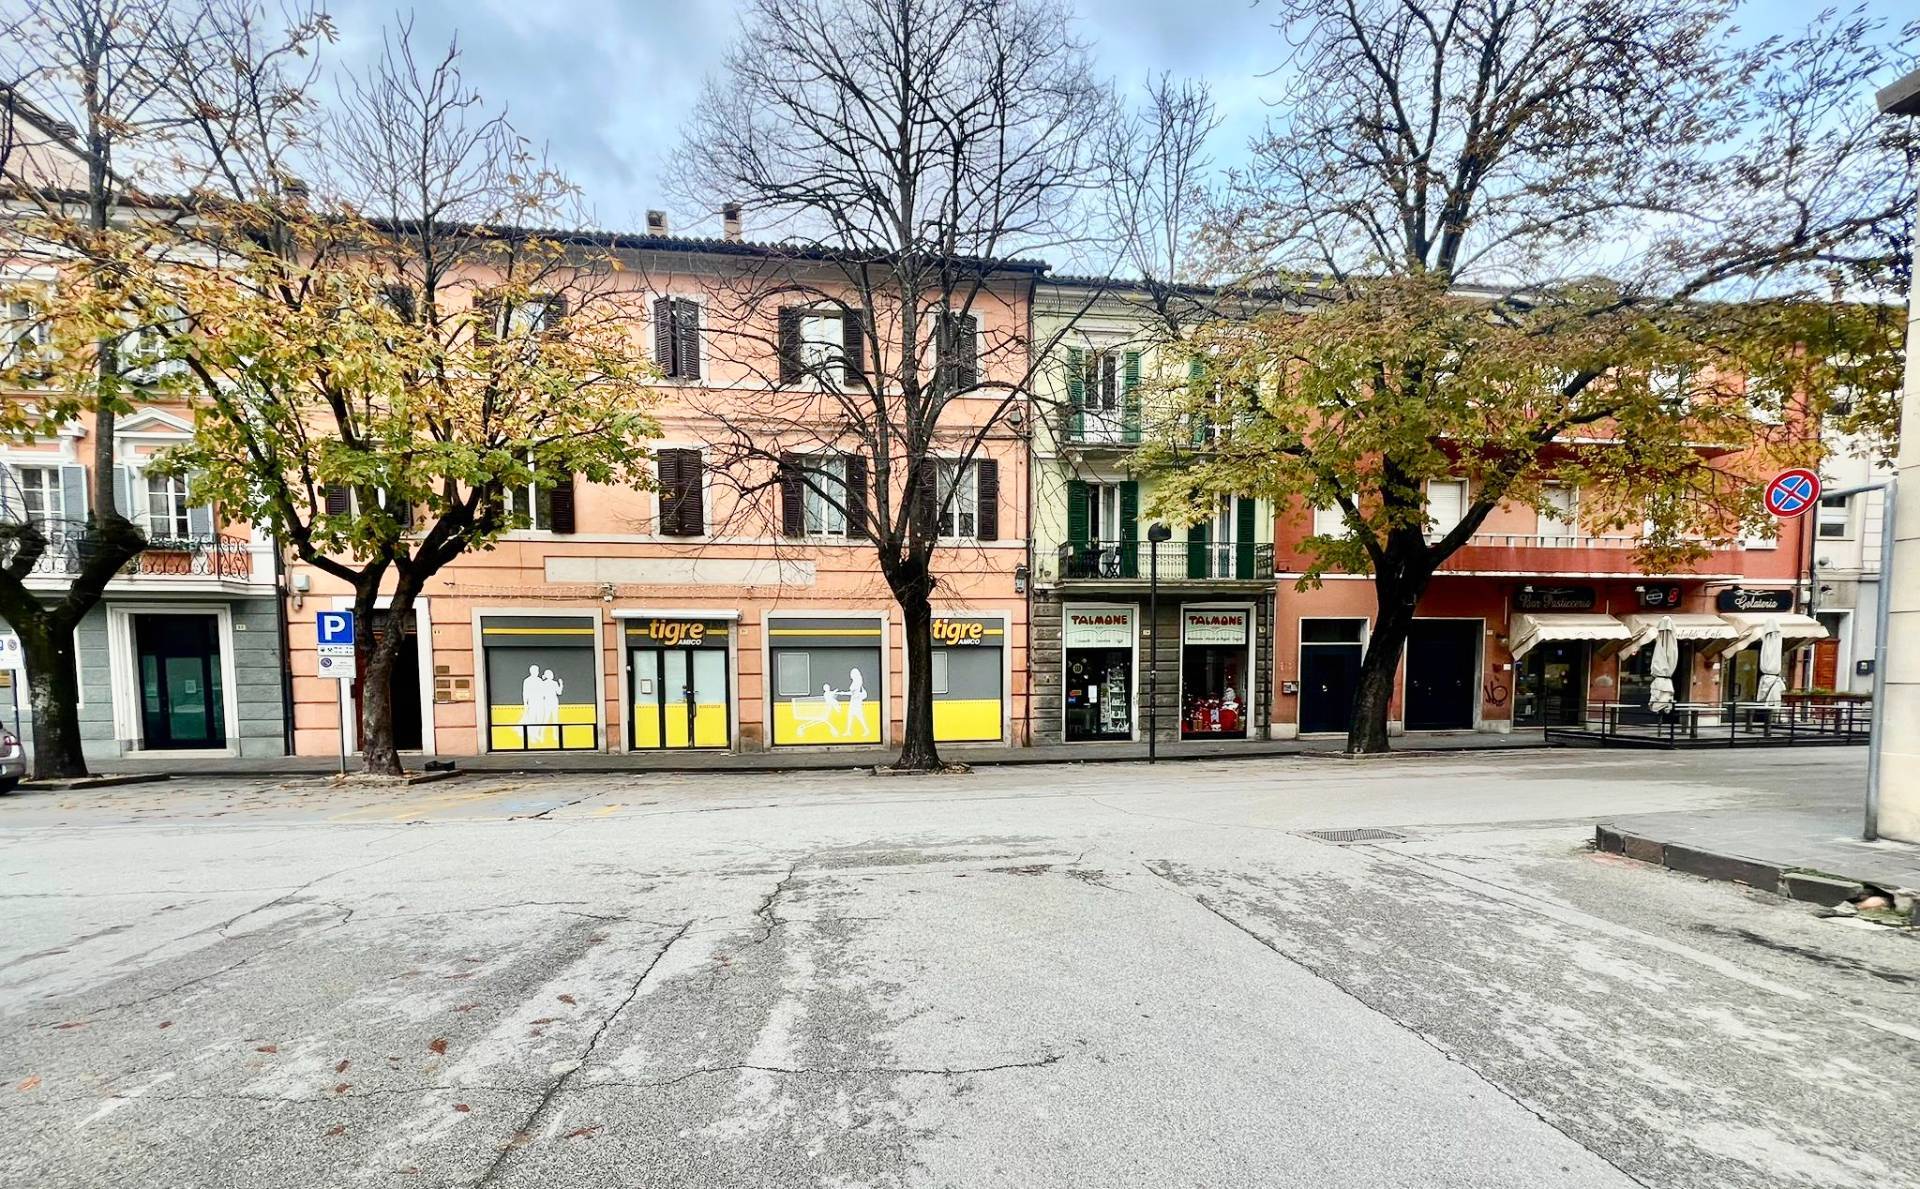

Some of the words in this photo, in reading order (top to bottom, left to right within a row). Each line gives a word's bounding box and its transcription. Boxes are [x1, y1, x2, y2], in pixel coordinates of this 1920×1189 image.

[1735, 595, 1778, 610] Gelateria
[324, 615, 345, 640] P
[1071, 615, 1128, 625] TALMONE
[1189, 615, 1243, 625] TALMONE
[650, 619, 704, 645] tigre
[932, 619, 983, 645] tigre
